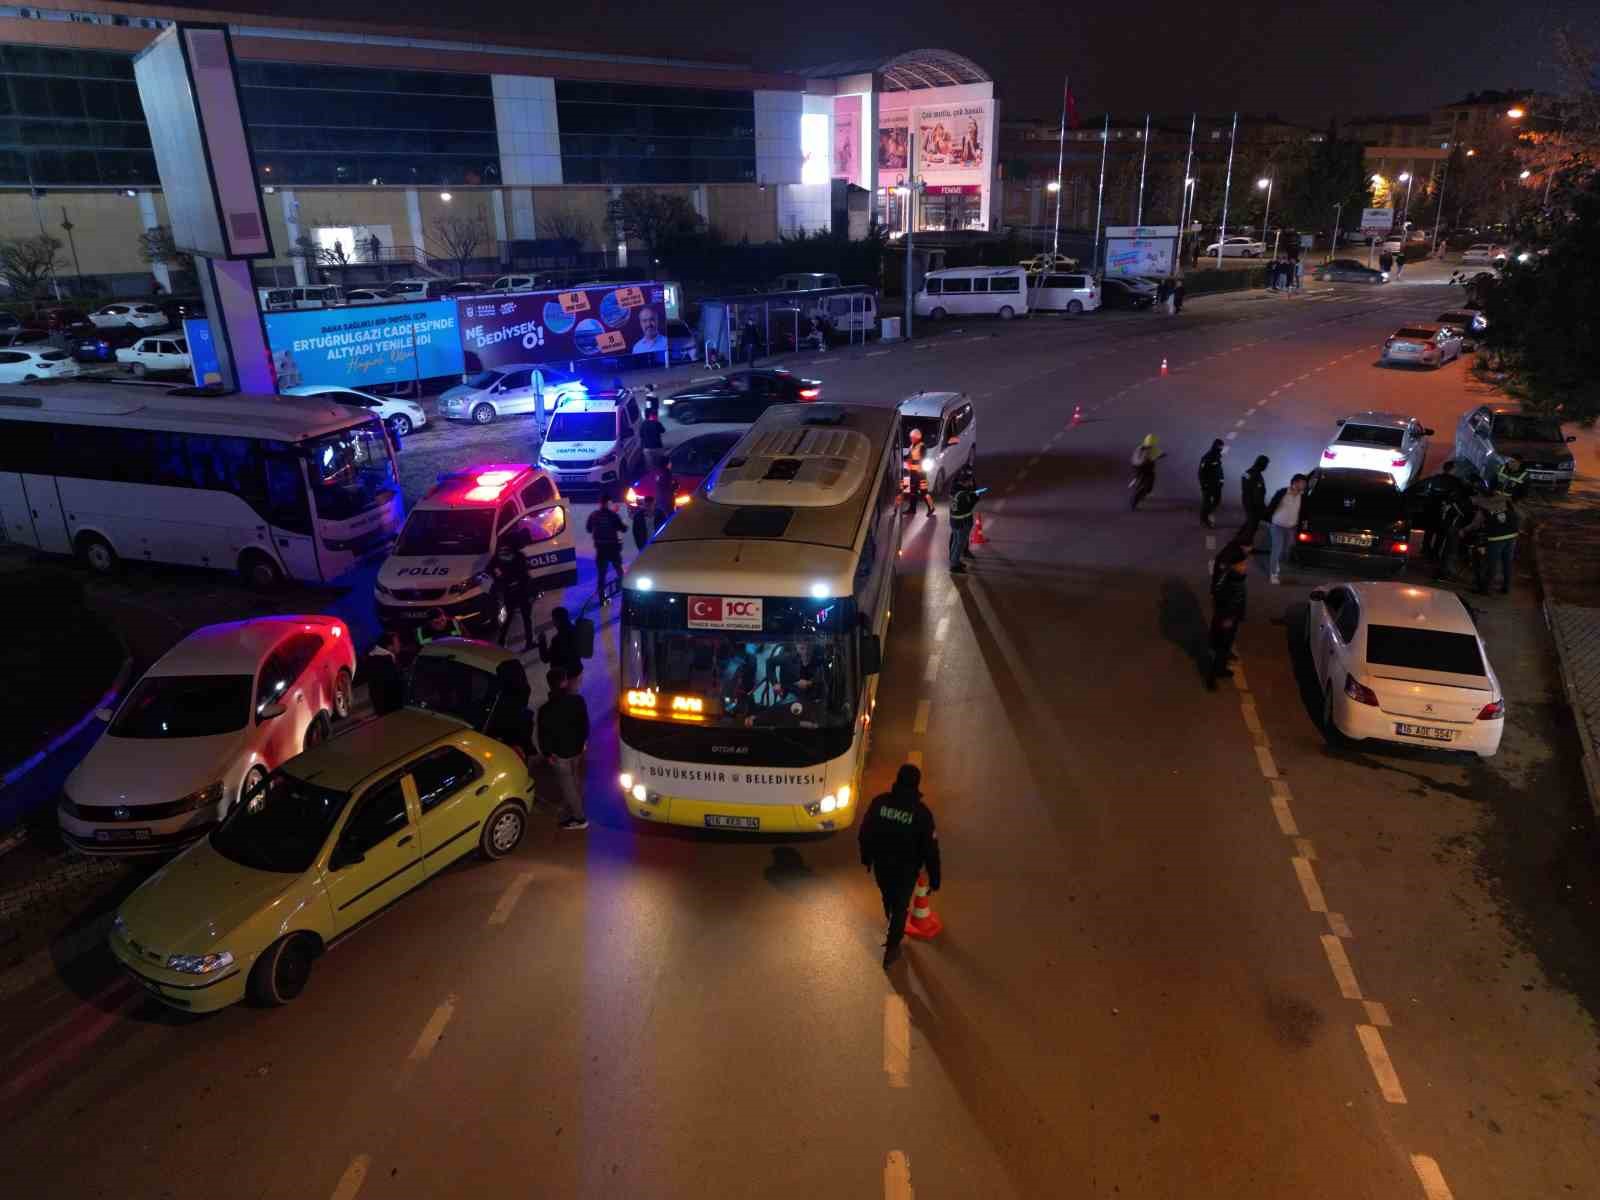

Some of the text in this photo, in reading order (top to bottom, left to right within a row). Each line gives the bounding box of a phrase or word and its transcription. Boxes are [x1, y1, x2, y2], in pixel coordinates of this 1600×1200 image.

[465, 325, 484, 340] NE
[476, 320, 536, 348] DEDİYSEK
[523, 326, 545, 349] O!
[328, 344, 373, 360] ALTYAPI
